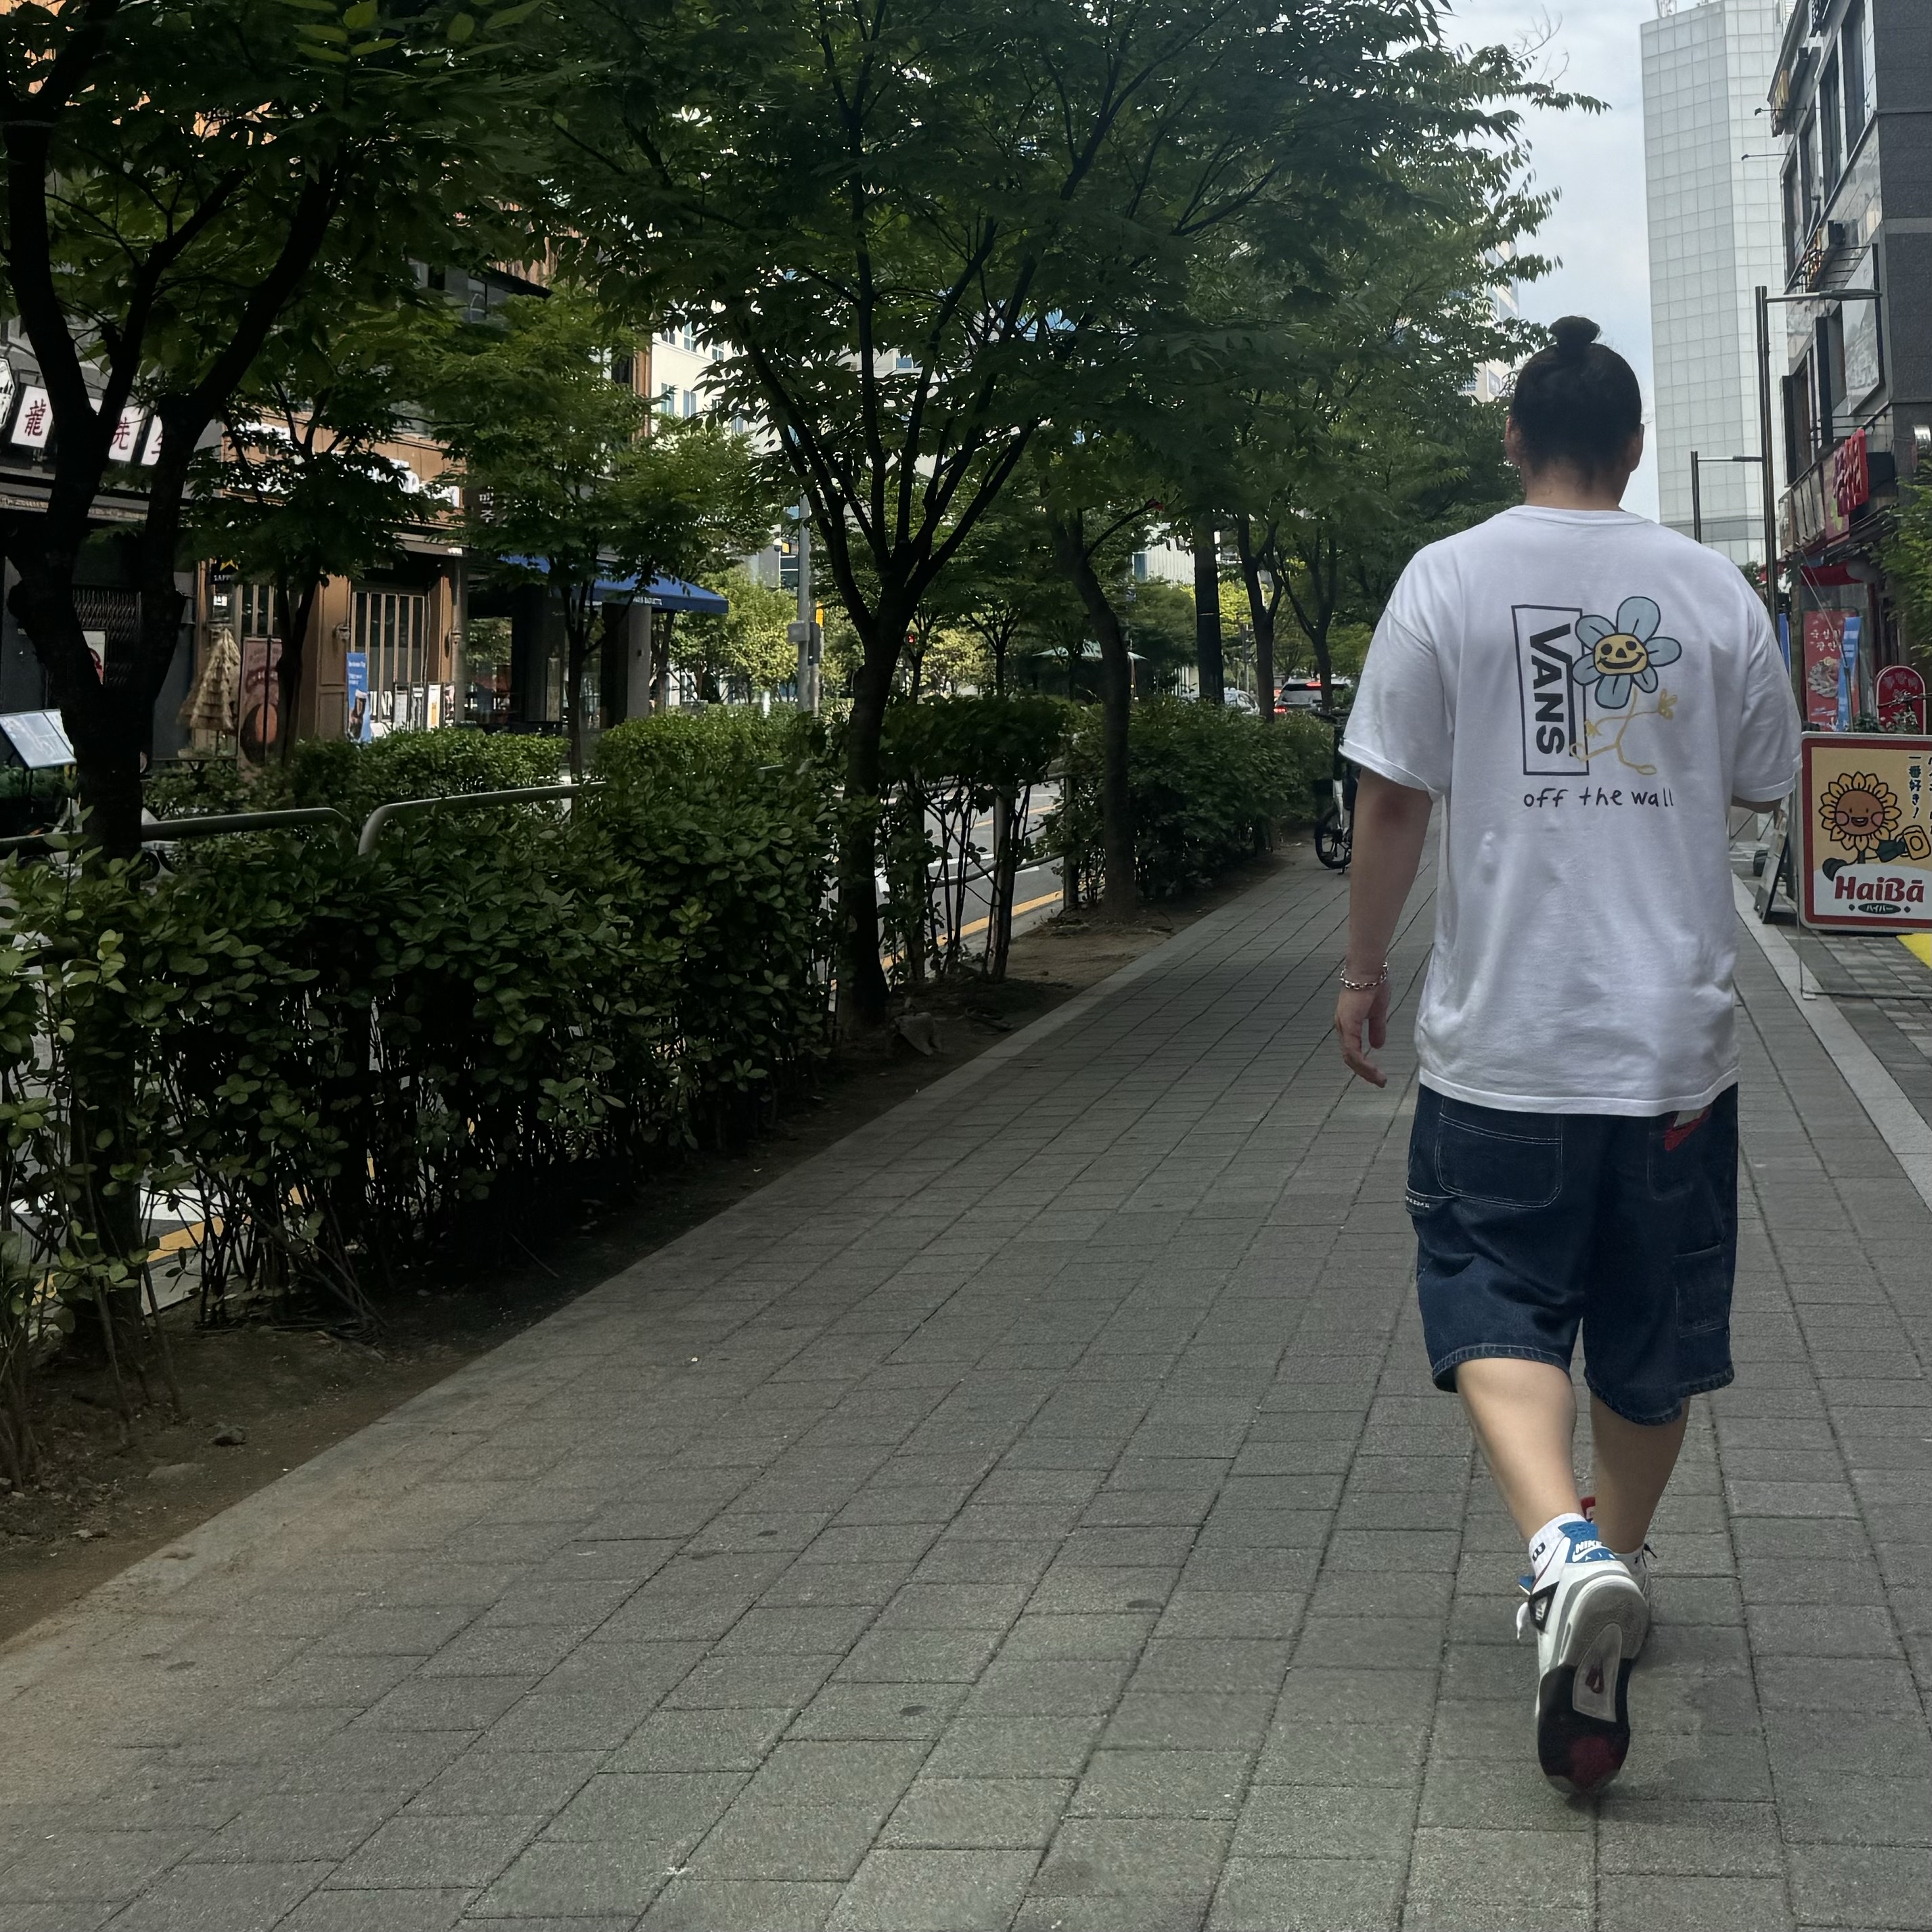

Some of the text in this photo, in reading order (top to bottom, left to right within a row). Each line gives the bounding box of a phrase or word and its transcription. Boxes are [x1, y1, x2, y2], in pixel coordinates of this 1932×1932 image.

[1529, 623, 1577, 757] VANS
[1523, 786, 1673, 808] off the wall
[1835, 875, 1925, 903] HaiBā
[1575, 1540, 1602, 1554] NIKE
